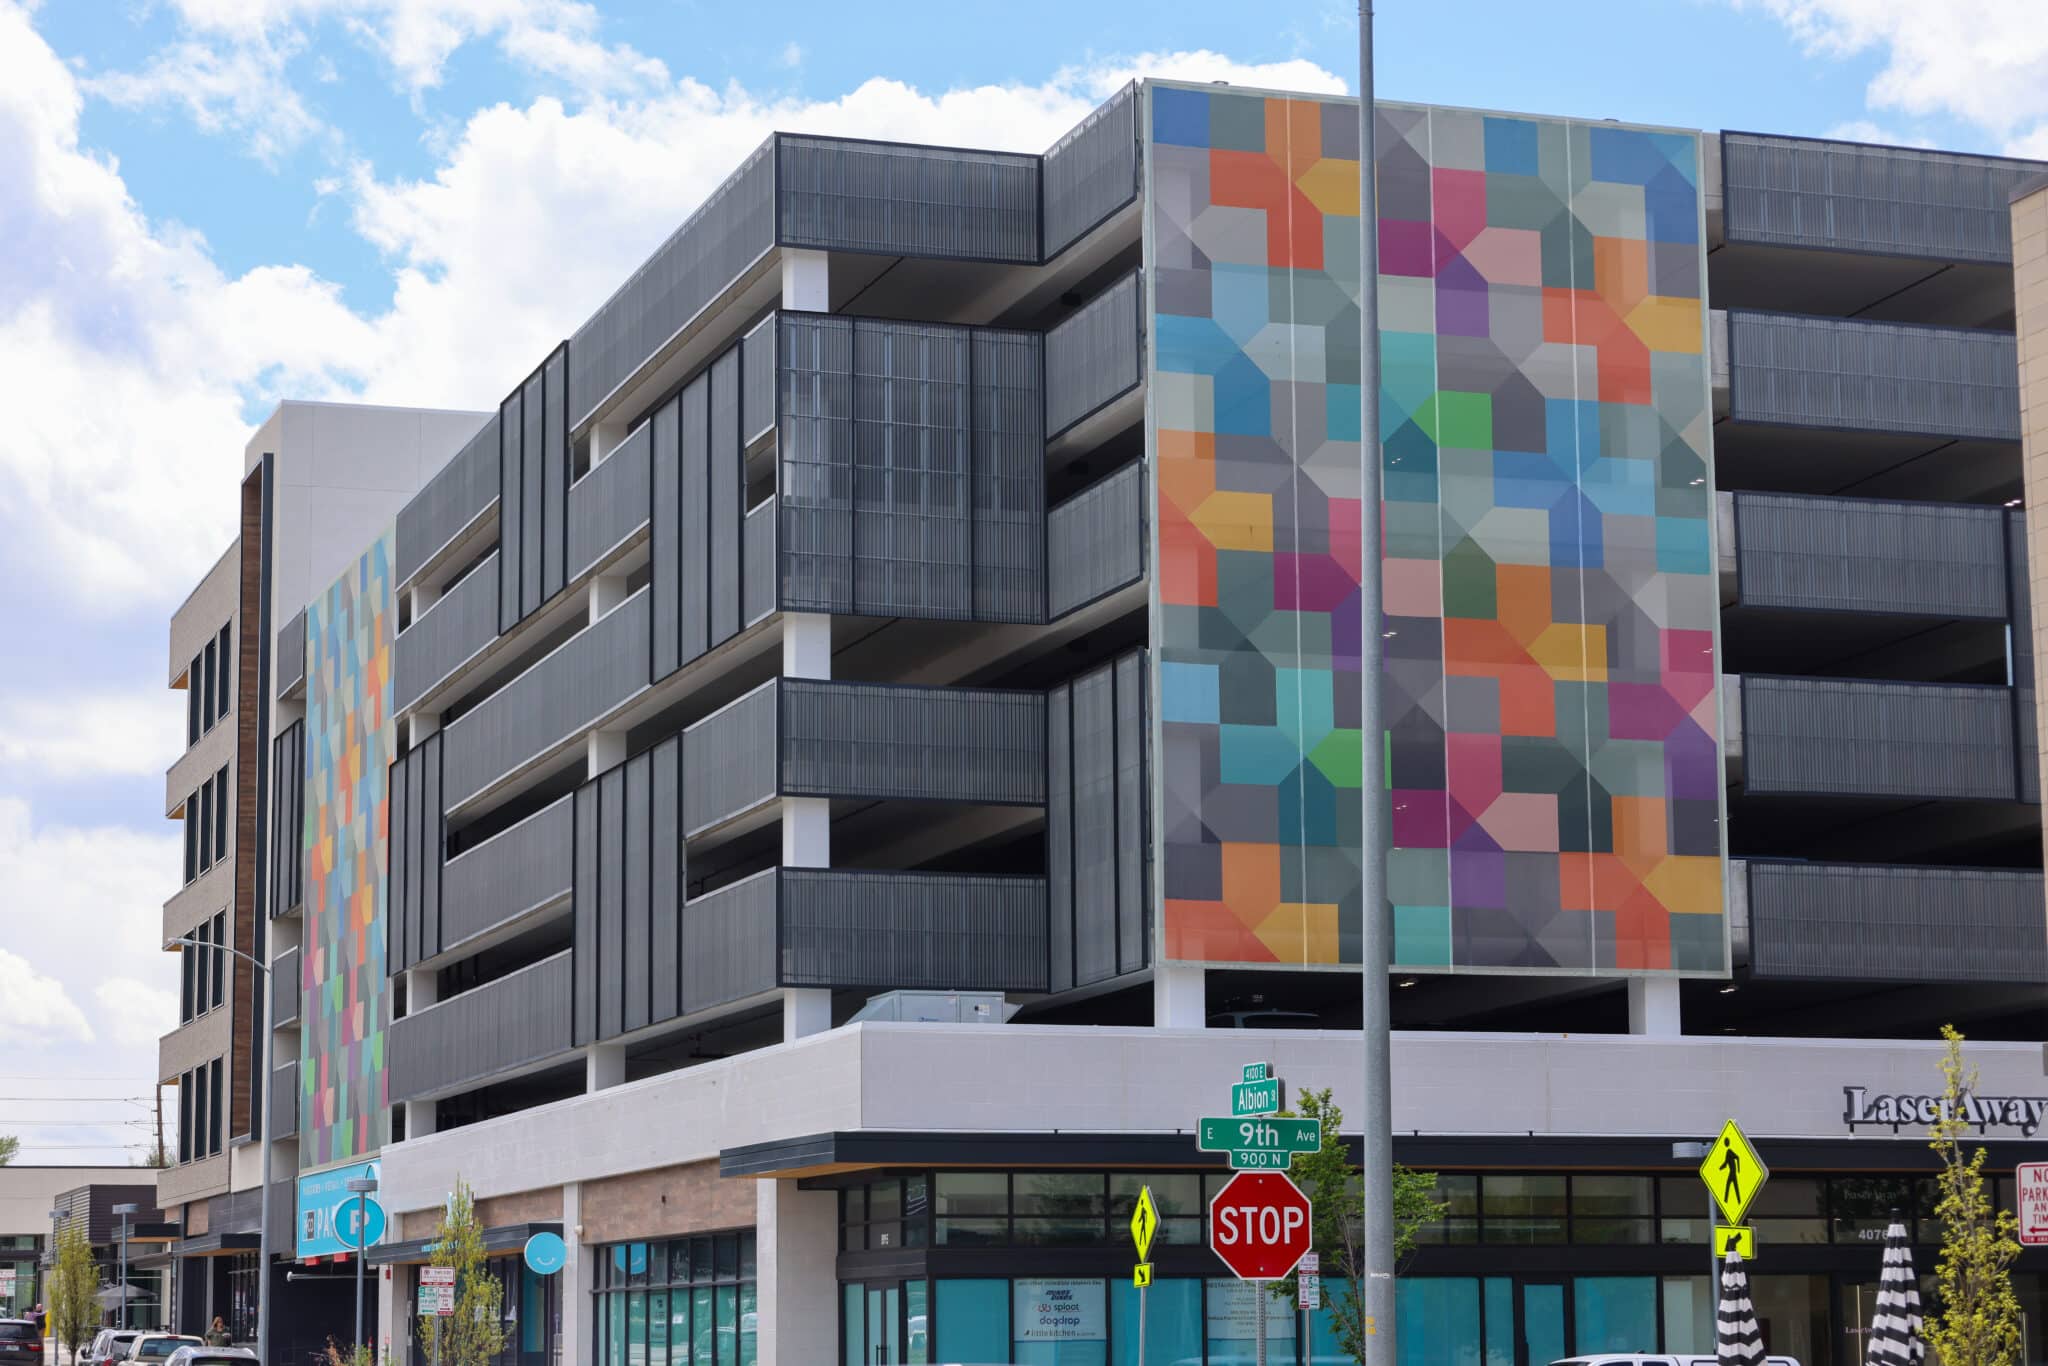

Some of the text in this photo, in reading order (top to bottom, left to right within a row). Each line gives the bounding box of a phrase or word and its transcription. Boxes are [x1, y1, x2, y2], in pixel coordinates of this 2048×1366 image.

[1259, 1065, 1264, 1079] E
[1238, 1087, 1268, 1111] Albion
[1844, 1086, 2048, 1137] LaserAway
[1207, 1122, 1316, 1146] E 9th Ave
[1240, 1153, 1281, 1165] 900 N
[2022, 1187, 2048, 1201] PARK
[2034, 1202, 2048, 1212] AN
[349, 1209, 370, 1235] P
[1218, 1205, 1304, 1245] STOP
[2033, 1213, 2048, 1225] TIM
[1039, 1315, 1080, 1327] dogdrop
